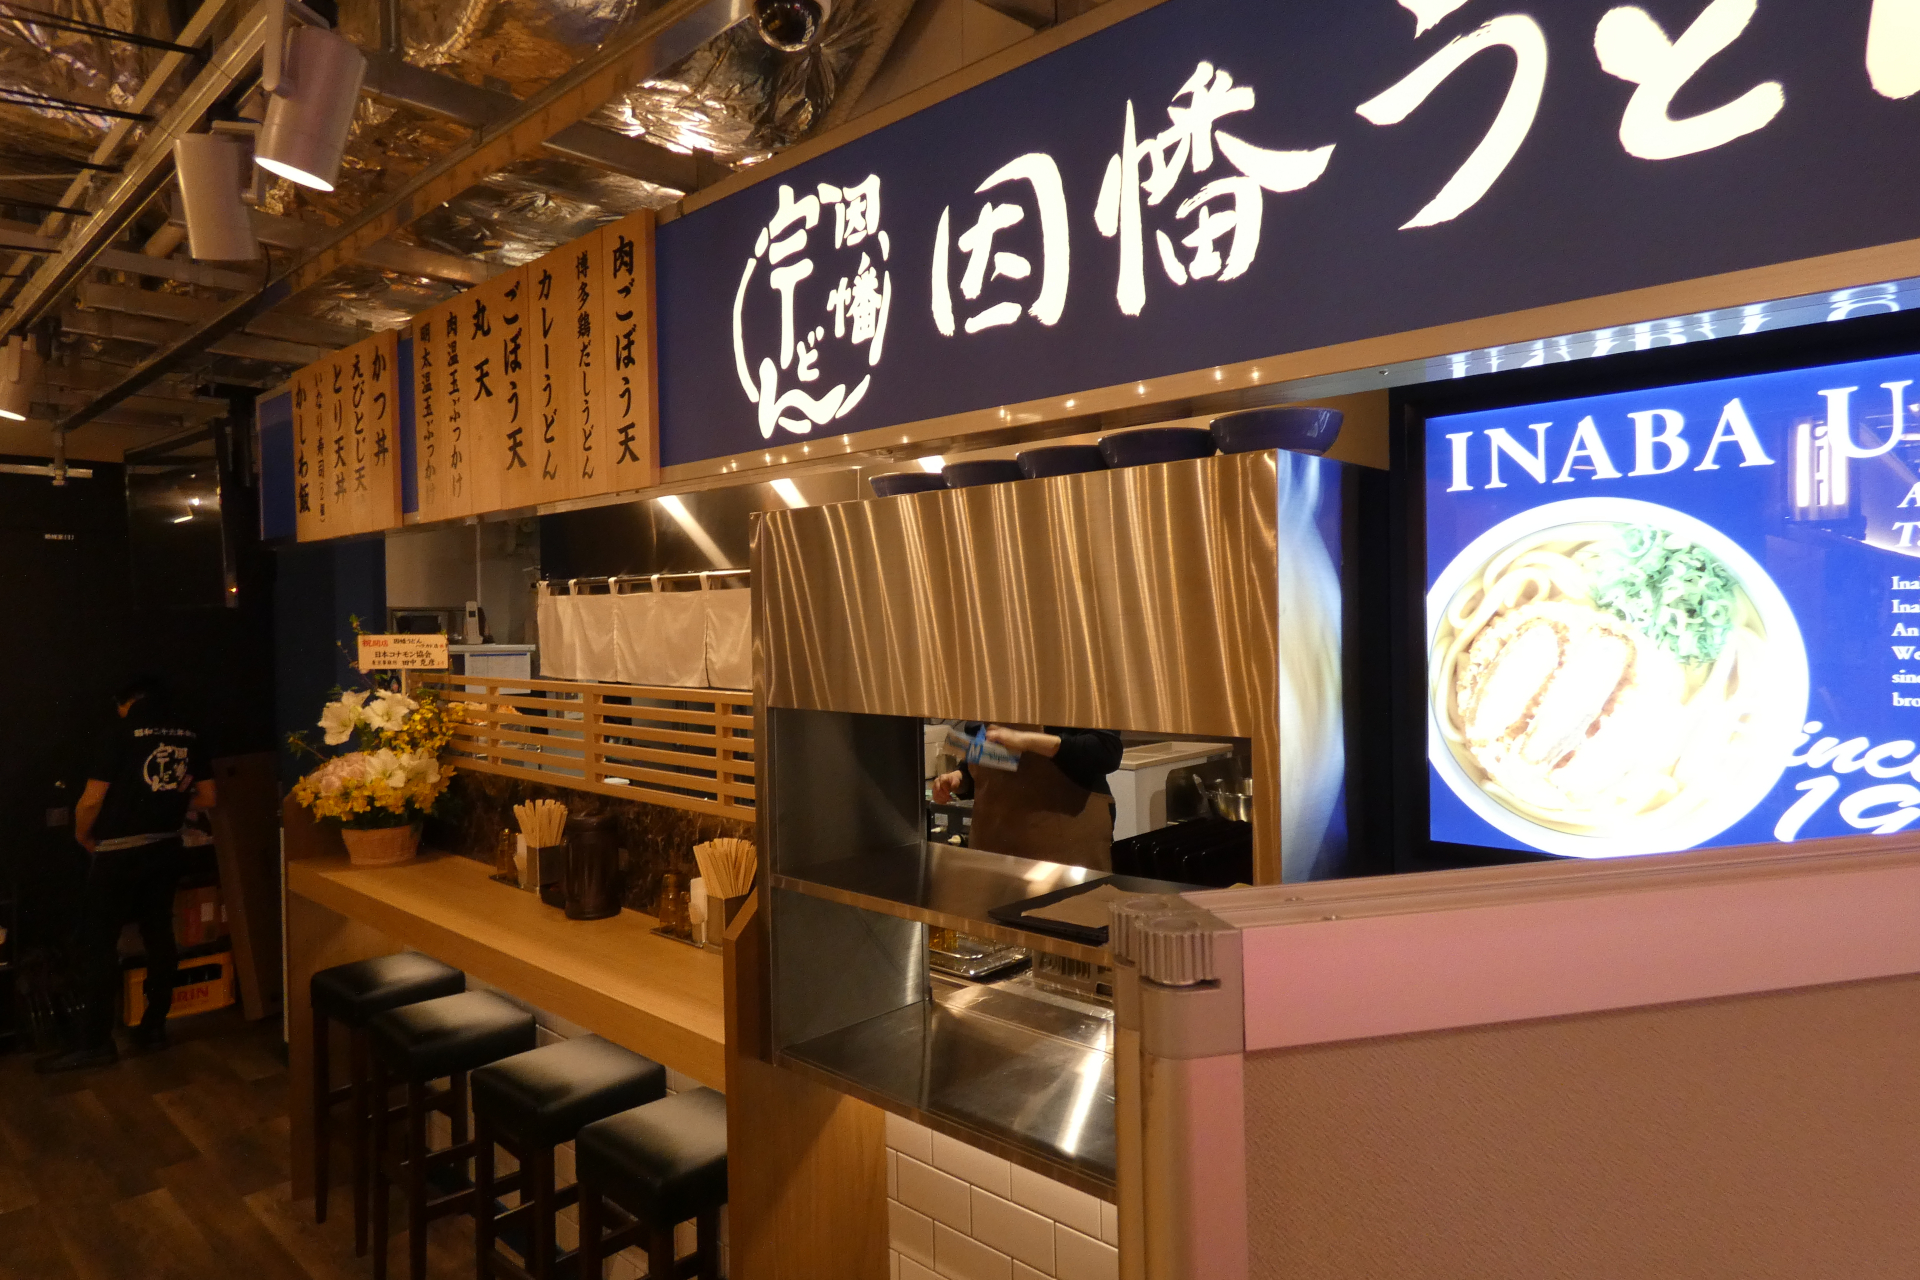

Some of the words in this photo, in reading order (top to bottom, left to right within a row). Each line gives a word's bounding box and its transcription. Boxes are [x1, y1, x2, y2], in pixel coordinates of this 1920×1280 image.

[826, 174, 883, 344] 因幡
[372, 345, 389, 467] かつ丼
[471, 299, 494, 401] 丸天
[502, 280, 528, 471] ごぼう天
[538, 268, 558, 481] カレーうどん
[575, 250, 594, 480] 博多鶏だしうどん
[612, 234, 640, 465] 肉ごぼう天
[295, 380, 311, 513] かしわ飯
[332, 363, 347, 504] とり天丼
[351, 353, 368, 502] えびとじ天
[1445, 397, 1776, 493] INABA
[1892, 521, 1920, 547] T
[362, 639, 389, 647] 祝開店
[374, 650, 432, 659] 日本コナモン協会
